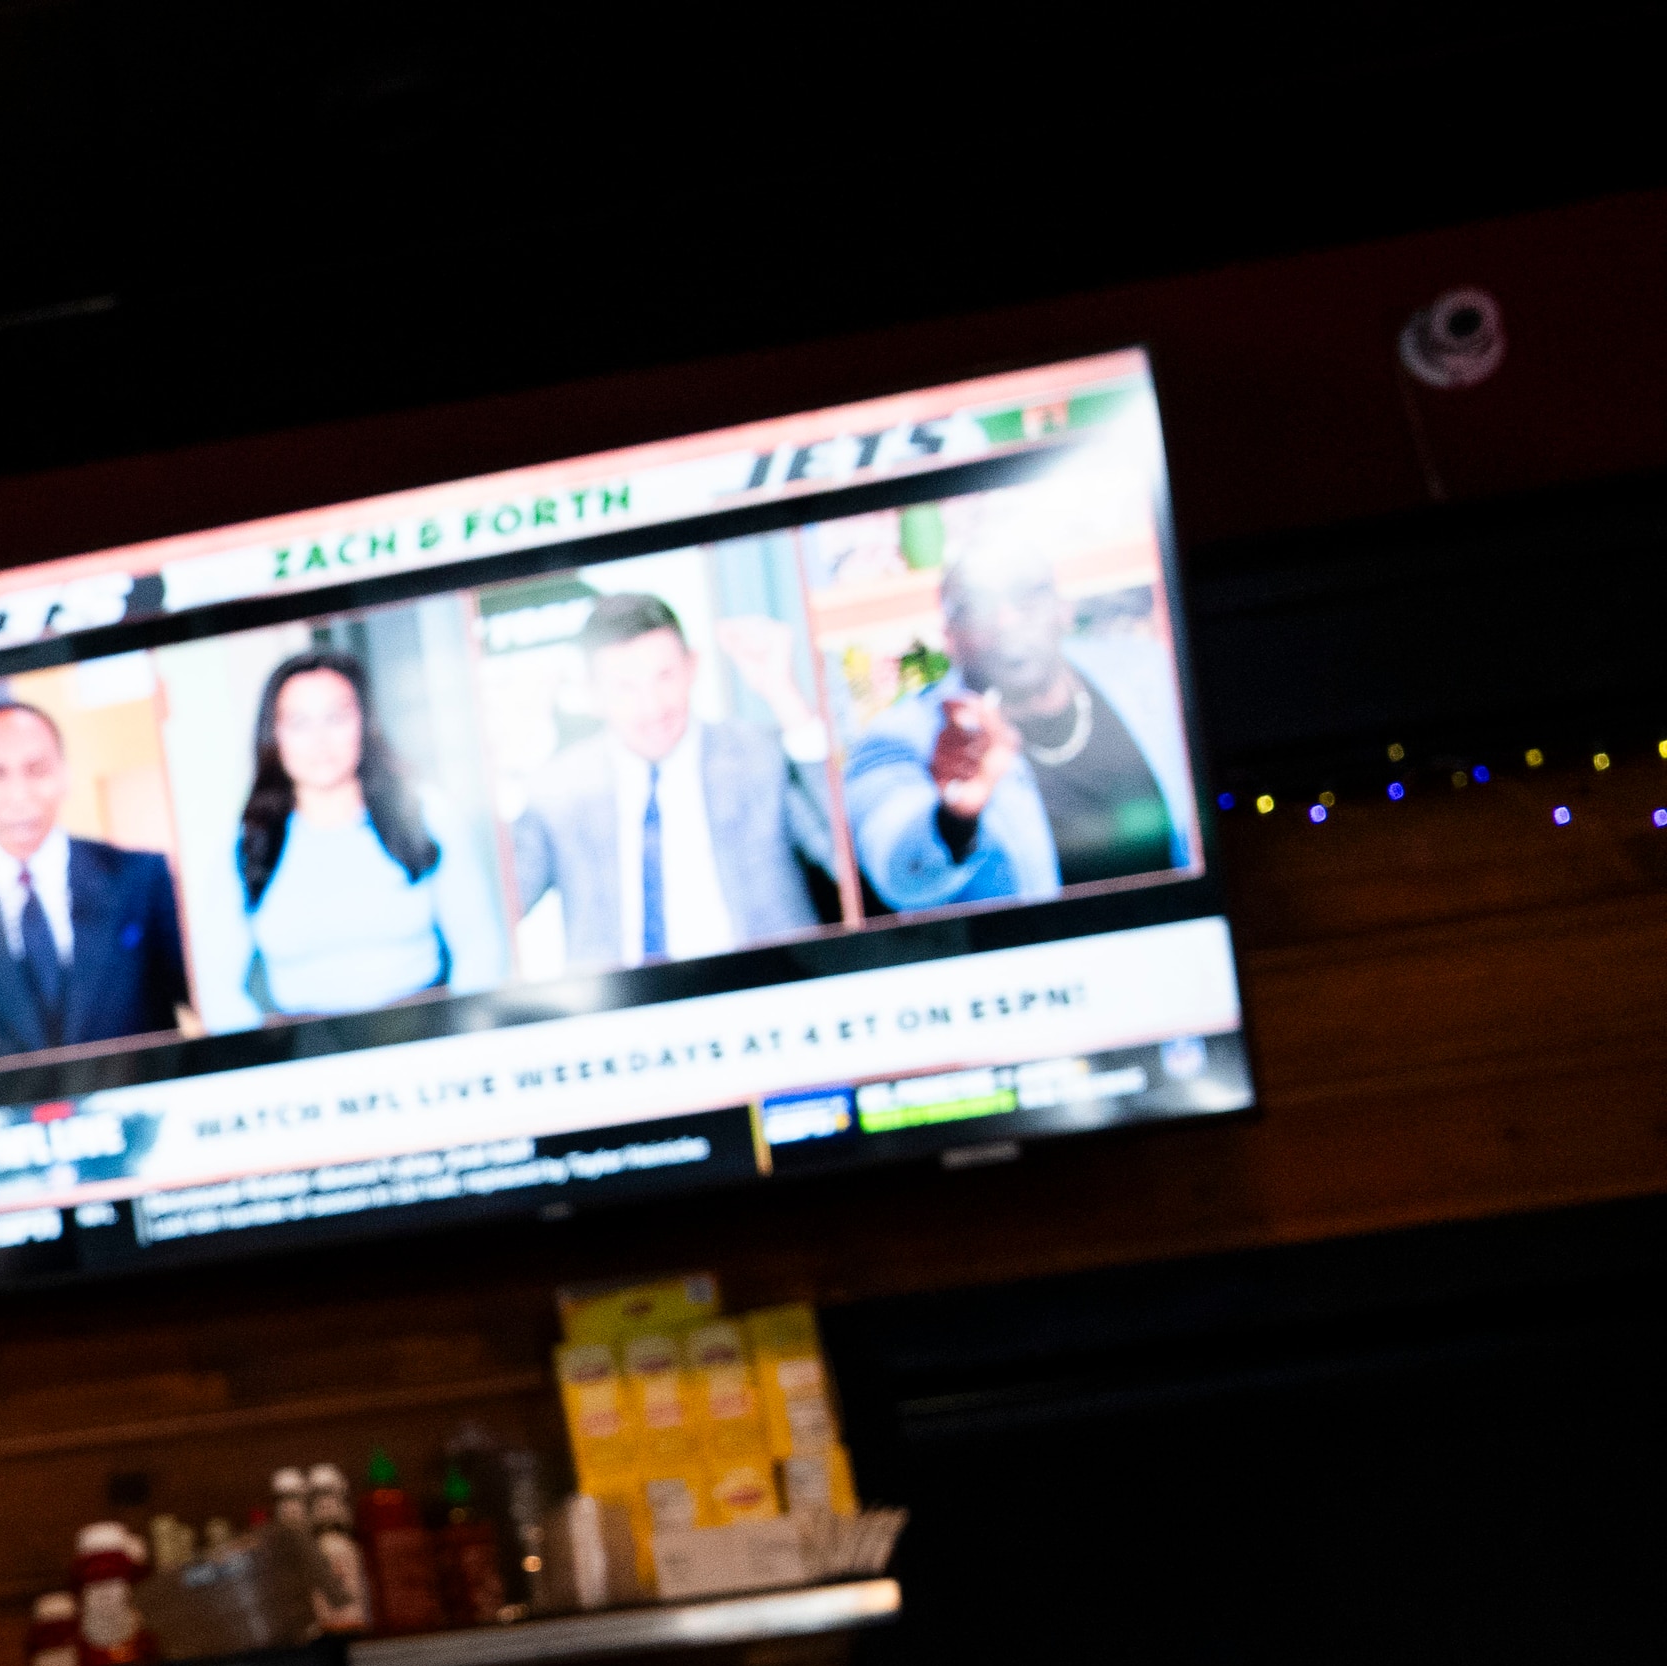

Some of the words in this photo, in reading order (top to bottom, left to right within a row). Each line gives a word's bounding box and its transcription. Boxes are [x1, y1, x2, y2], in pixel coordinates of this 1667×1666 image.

[269, 530, 396, 581] ZACH
[416, 518, 442, 552] &
[463, 483, 633, 545] FORTH
[417, 1074, 496, 1105] LIVE
[517, 1040, 723, 1090] WEEKDAYS
[742, 1028, 783, 1056] AT
[802, 1023, 821, 1045] 4
[837, 1014, 877, 1042] ET
[897, 1003, 952, 1033] ON
